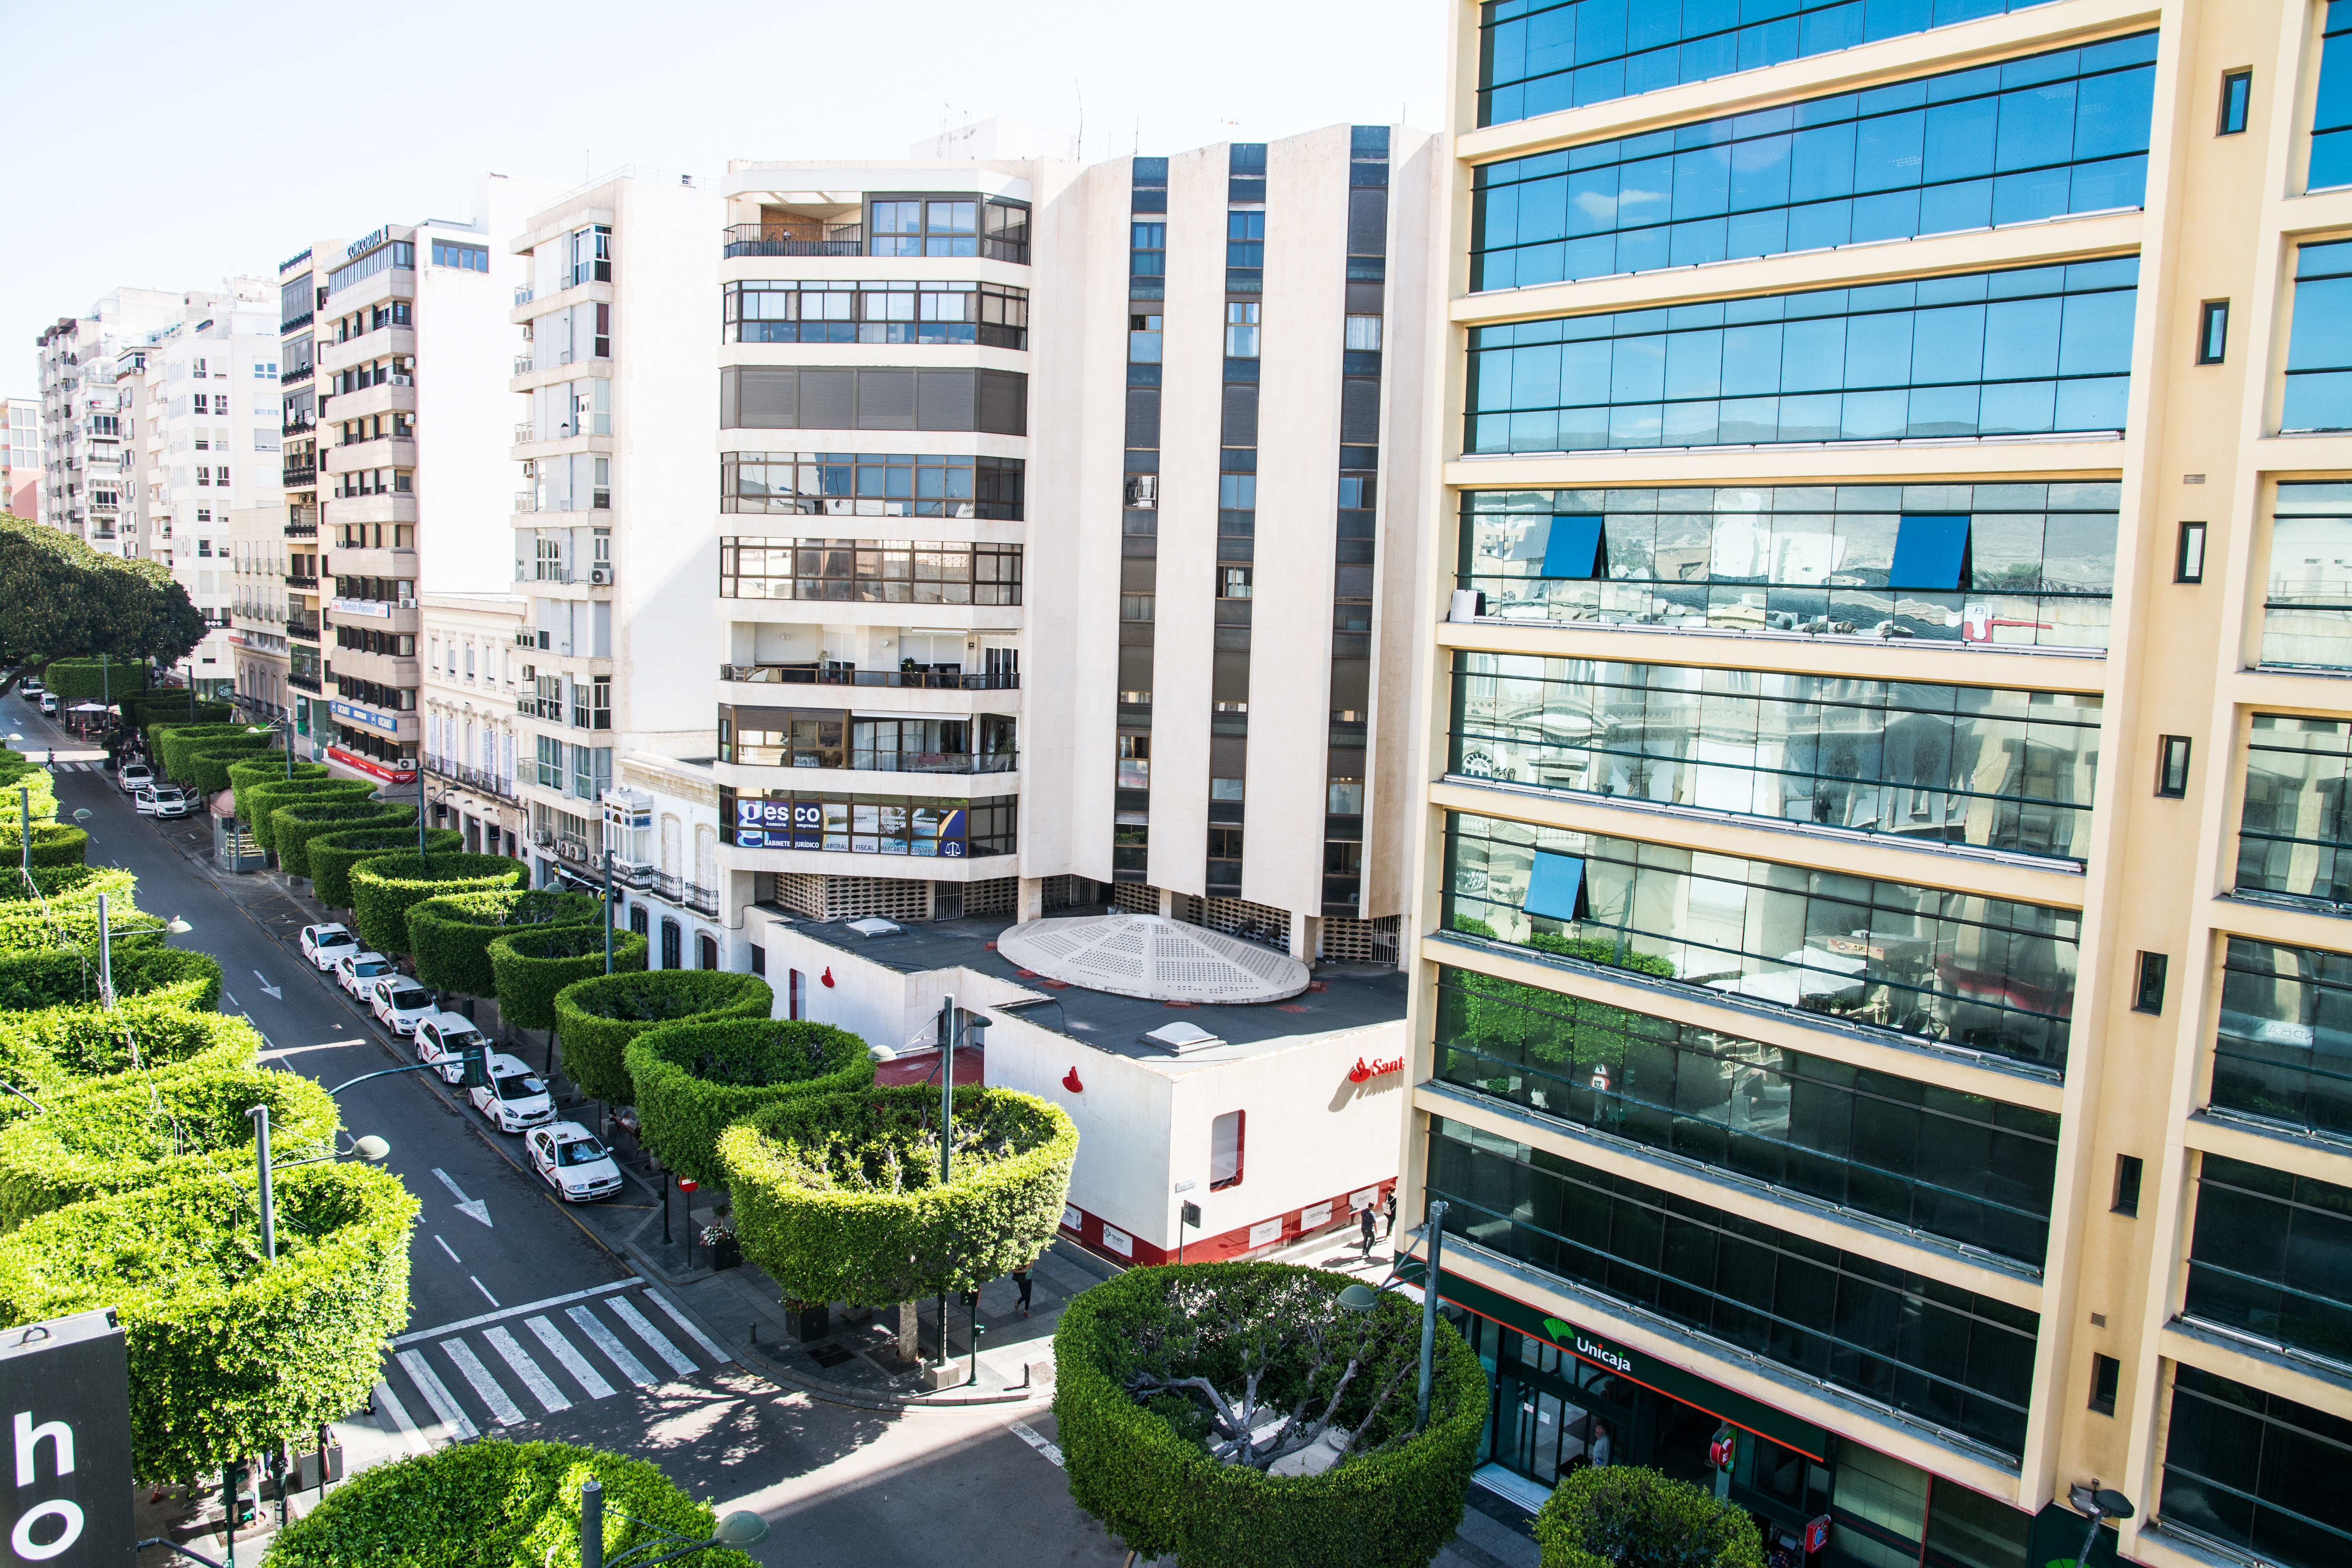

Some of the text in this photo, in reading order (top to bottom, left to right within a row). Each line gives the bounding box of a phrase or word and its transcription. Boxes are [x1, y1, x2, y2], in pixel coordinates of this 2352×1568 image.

[347, 225, 388, 259] CONCORDIA 4
[342, 601, 376, 614] Partido Popular
[338, 704, 350, 716] OCASO
[378, 716, 392, 729] OCASO
[1372, 1056, 1405, 1076] Sant
[1577, 1336, 1631, 1372] Unicaja
